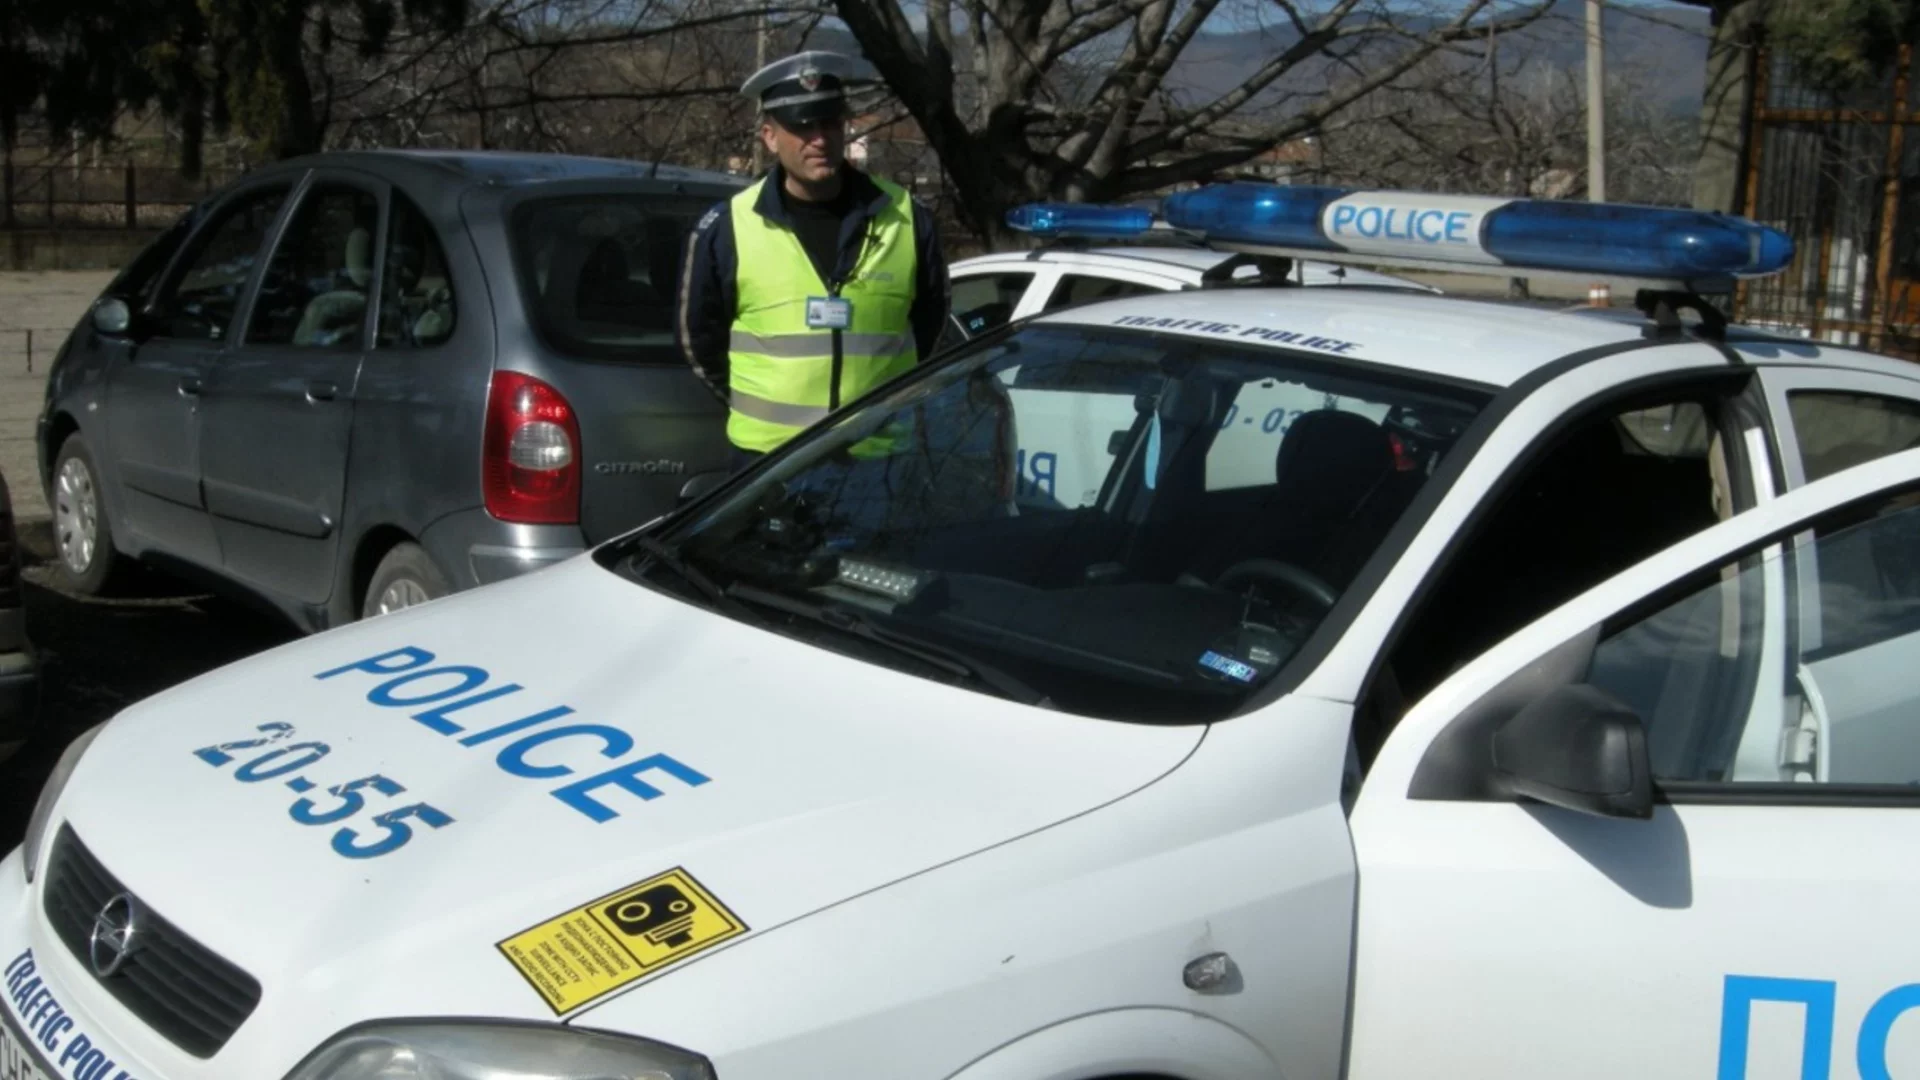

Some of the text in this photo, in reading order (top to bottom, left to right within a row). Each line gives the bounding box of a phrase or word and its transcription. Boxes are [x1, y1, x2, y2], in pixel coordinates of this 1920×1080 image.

[1333, 204, 1473, 243] POLICE
[1113, 315, 1364, 354] TRAFFIC POLICE
[594, 459, 684, 475] CITROËN
[313, 645, 713, 824] POLICE
[192, 721, 456, 859] 20-55
[573, 916, 593, 932] ЗОНА
[508, 944, 567, 1004] AND AUDIO RECORDING
[528, 948, 568, 986] SURVEILLANCE
[538, 940, 582, 983] ZONE WITH CCTV
[4, 946, 74, 1053] TRAFFIC
